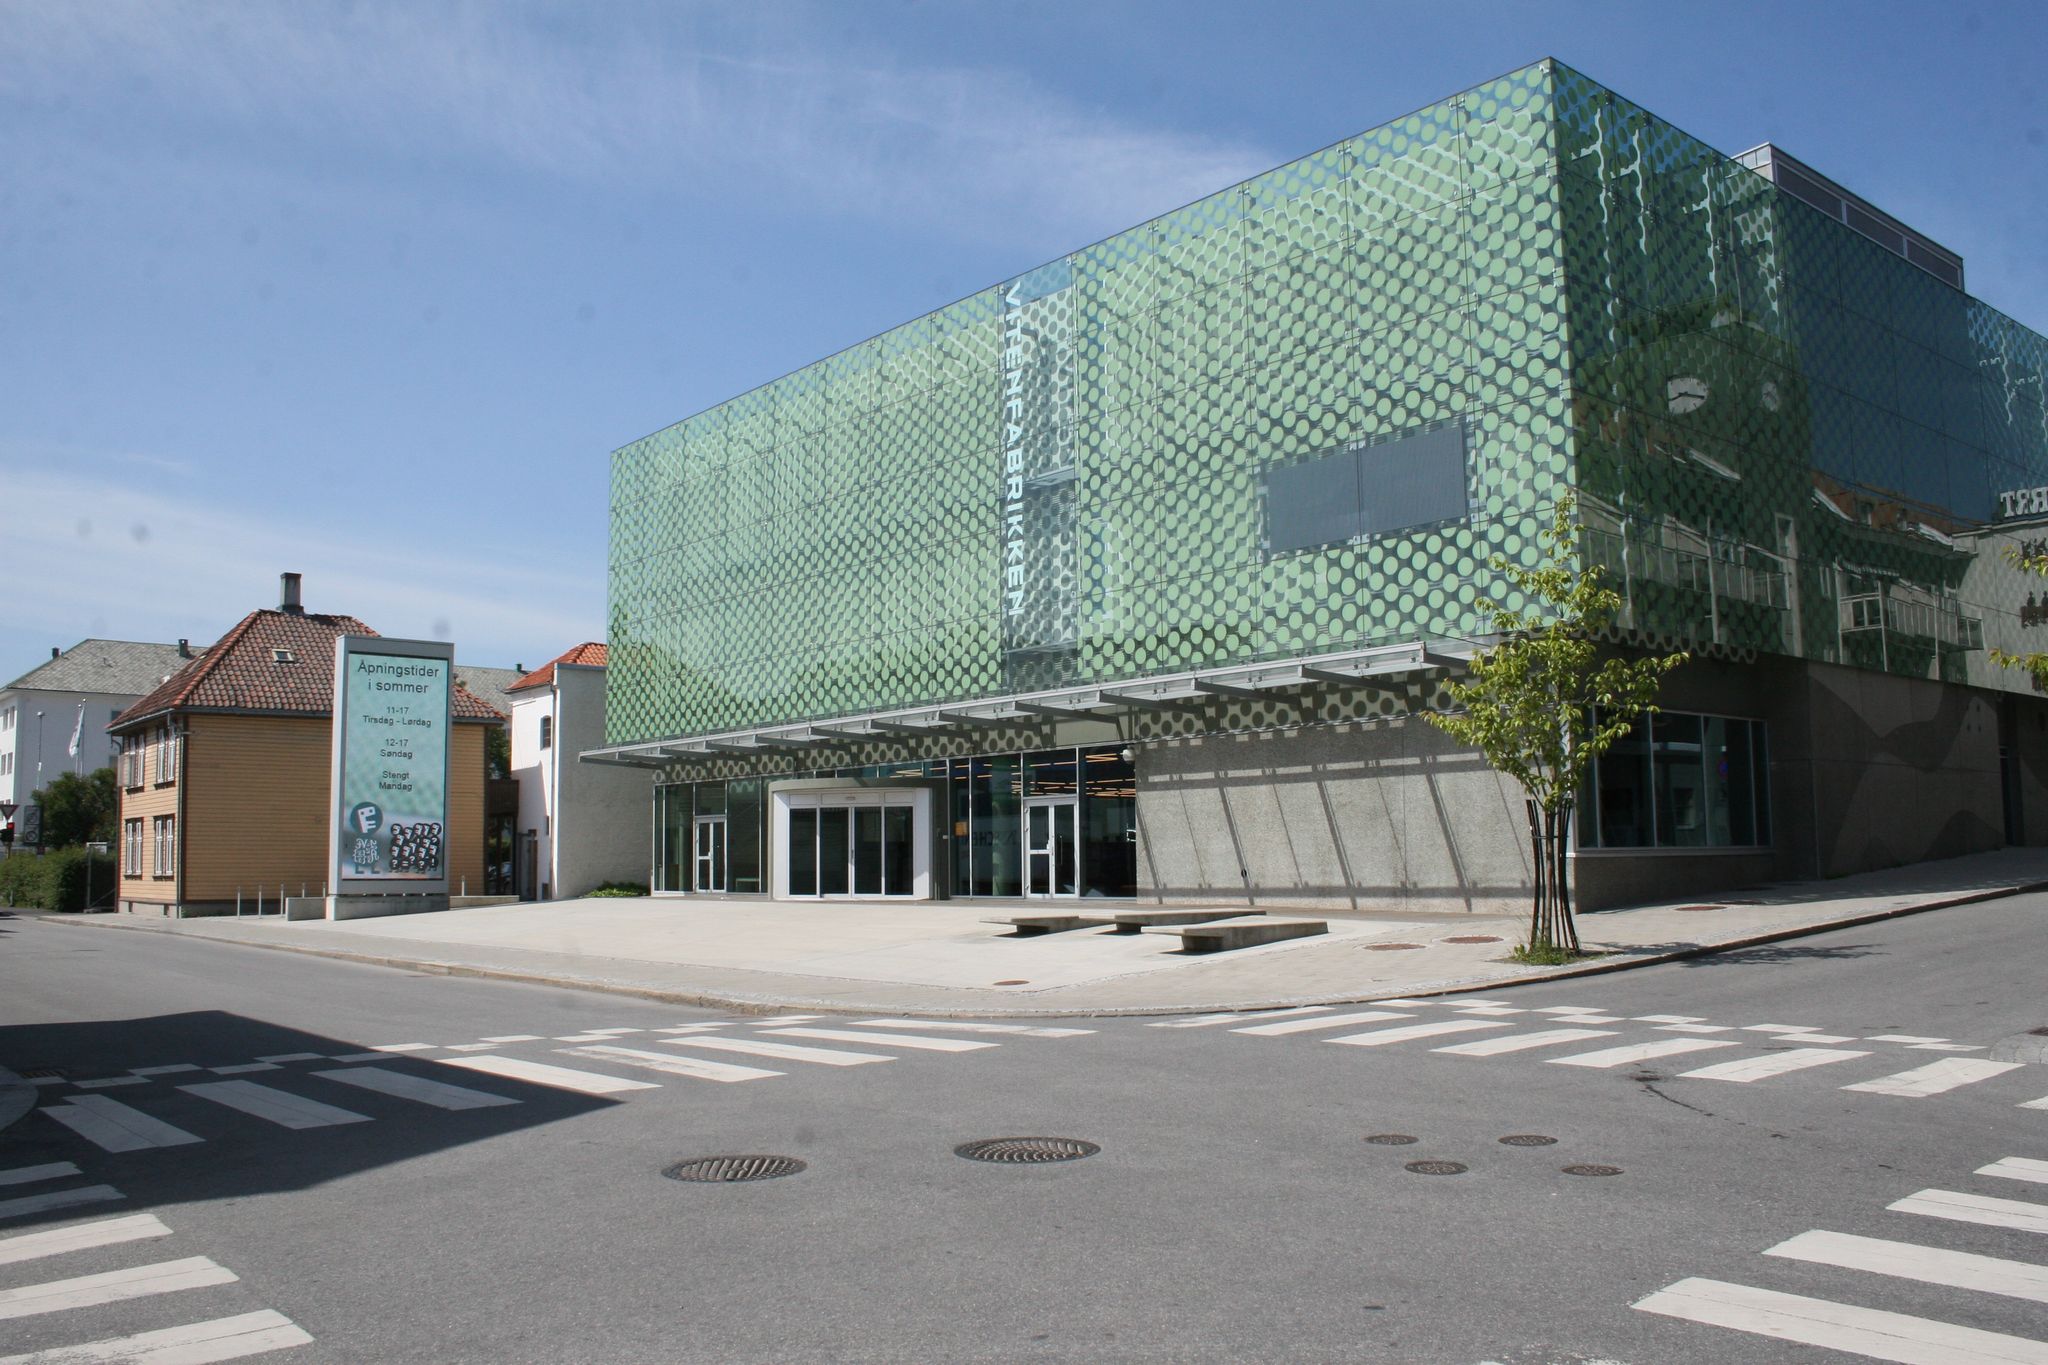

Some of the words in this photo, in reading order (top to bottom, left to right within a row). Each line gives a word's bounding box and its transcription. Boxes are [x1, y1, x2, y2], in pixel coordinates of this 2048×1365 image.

[1005, 281, 1025, 616] VITENFABRIKKEN
[357, 659, 440, 678] Åpningstider
[368, 679, 372, 690] i
[376, 682, 429, 693] sommer
[387, 706, 410, 714] 11-17
[362, 715, 394, 726] Tirsdag
[402, 717, 432, 728] Lørdag
[385, 738, 409, 747] 12-17
[380, 749, 413, 759] Søndag
[382, 770, 410, 780] Stengt
[379, 782, 413, 792] Mandag
